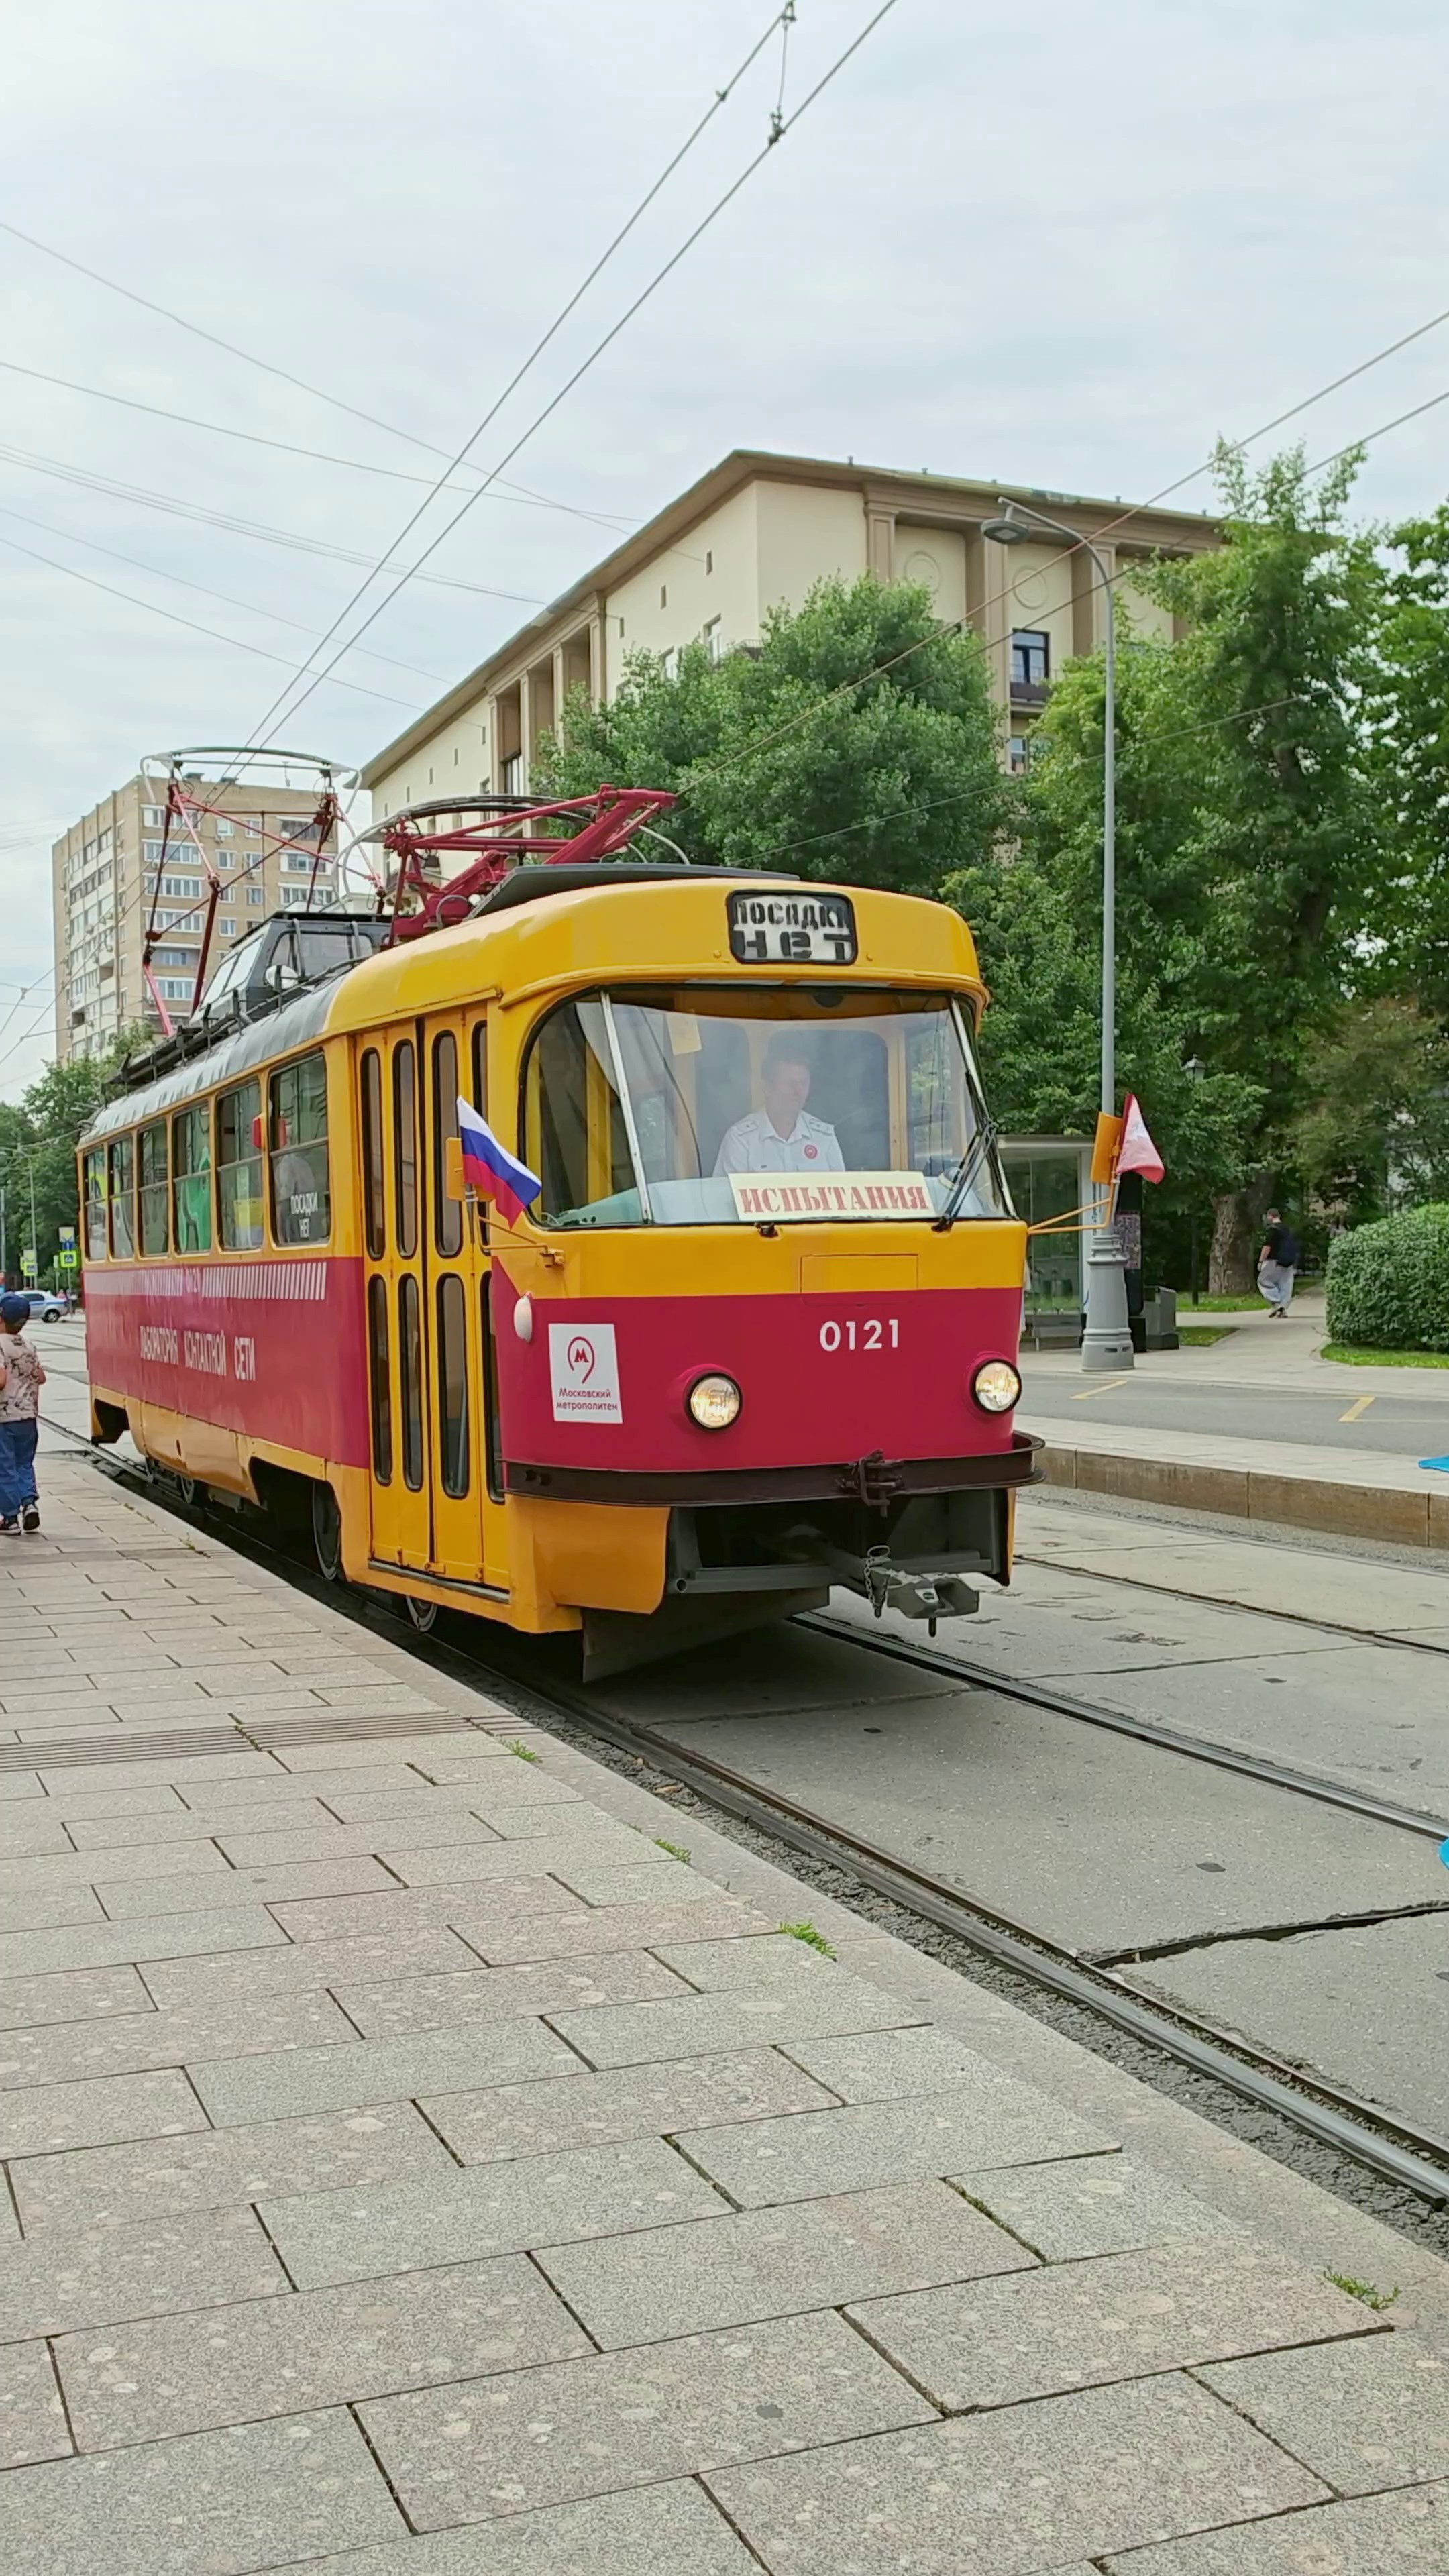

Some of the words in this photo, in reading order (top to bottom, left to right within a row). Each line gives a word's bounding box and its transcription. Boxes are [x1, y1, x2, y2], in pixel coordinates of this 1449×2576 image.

[290, 1191, 318, 1216] ПОСАДКИ
[739, 1186, 929, 1213] ИСПЫТАНИЯ
[299, 1218, 309, 1238] НЕТ
[820, 1319, 898, 1352] 0121
[184, 1329, 226, 1376] КОНТАКТНОЙ
[235, 1336, 255, 1381] СЕТИ
[559, 1387, 611, 1398] Московский
[556, 1401, 618, 1411] метрополитен
